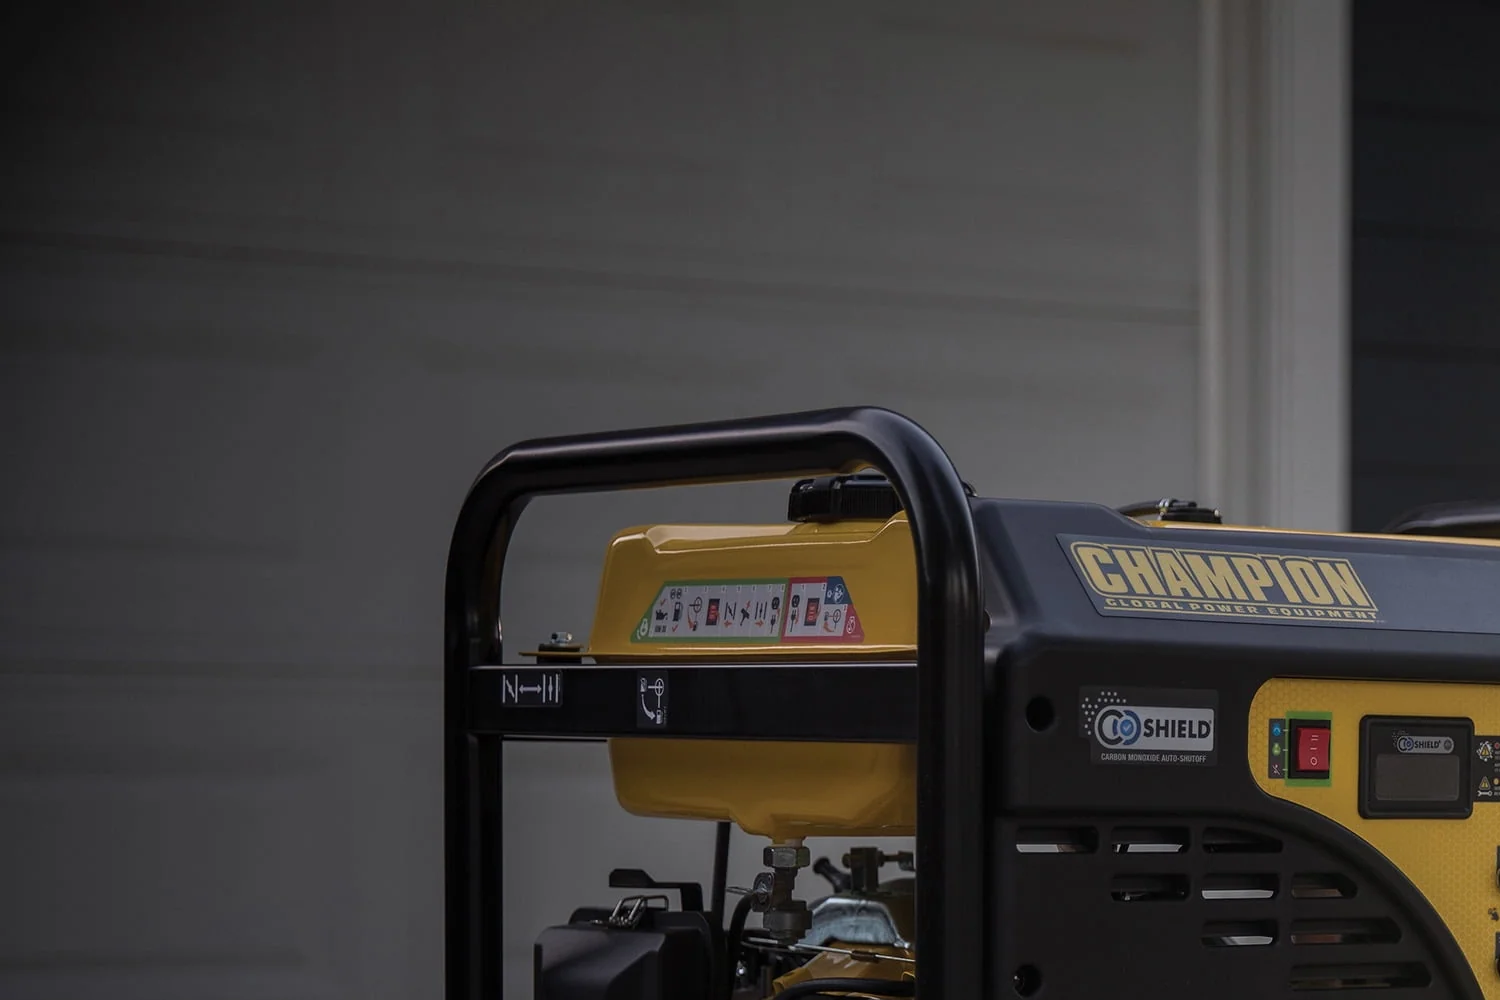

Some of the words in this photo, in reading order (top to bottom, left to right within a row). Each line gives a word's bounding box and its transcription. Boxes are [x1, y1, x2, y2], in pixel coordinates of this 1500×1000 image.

[1076, 545, 1371, 608] CHAMPION
[1104, 597, 1184, 611] GLOBAL
[1188, 602, 1259, 615] POWER
[1268, 606, 1378, 621] EQUIPMENT
[1100, 752, 1127, 762] CARBON
[1128, 752, 1160, 762] MONOXIDE
[1161, 754, 1207, 764] AUTO-SHUTOFF
